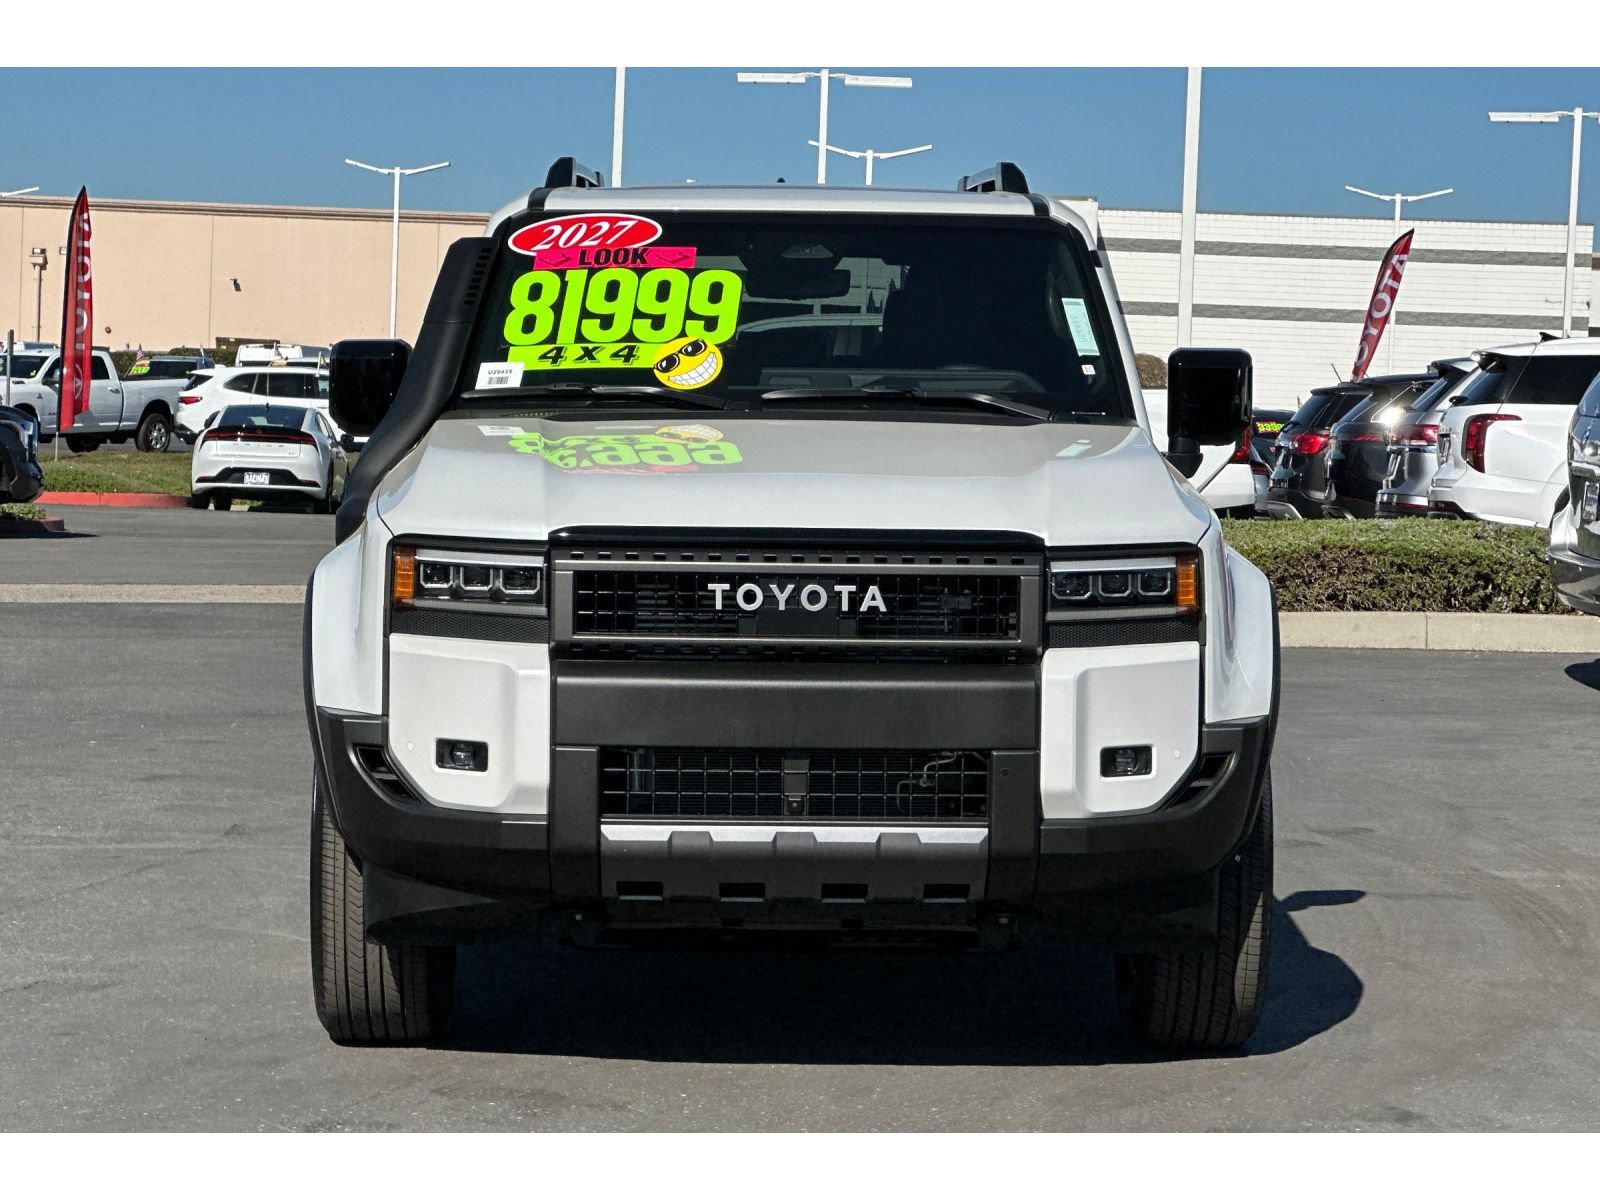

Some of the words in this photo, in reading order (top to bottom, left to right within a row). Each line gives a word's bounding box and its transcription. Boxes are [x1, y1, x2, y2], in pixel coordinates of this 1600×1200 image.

[534, 220, 638, 251] 2027
[577, 247, 650, 267] LOOK
[503, 268, 743, 346] 81999
[707, 583, 887, 612] TOYOTA
